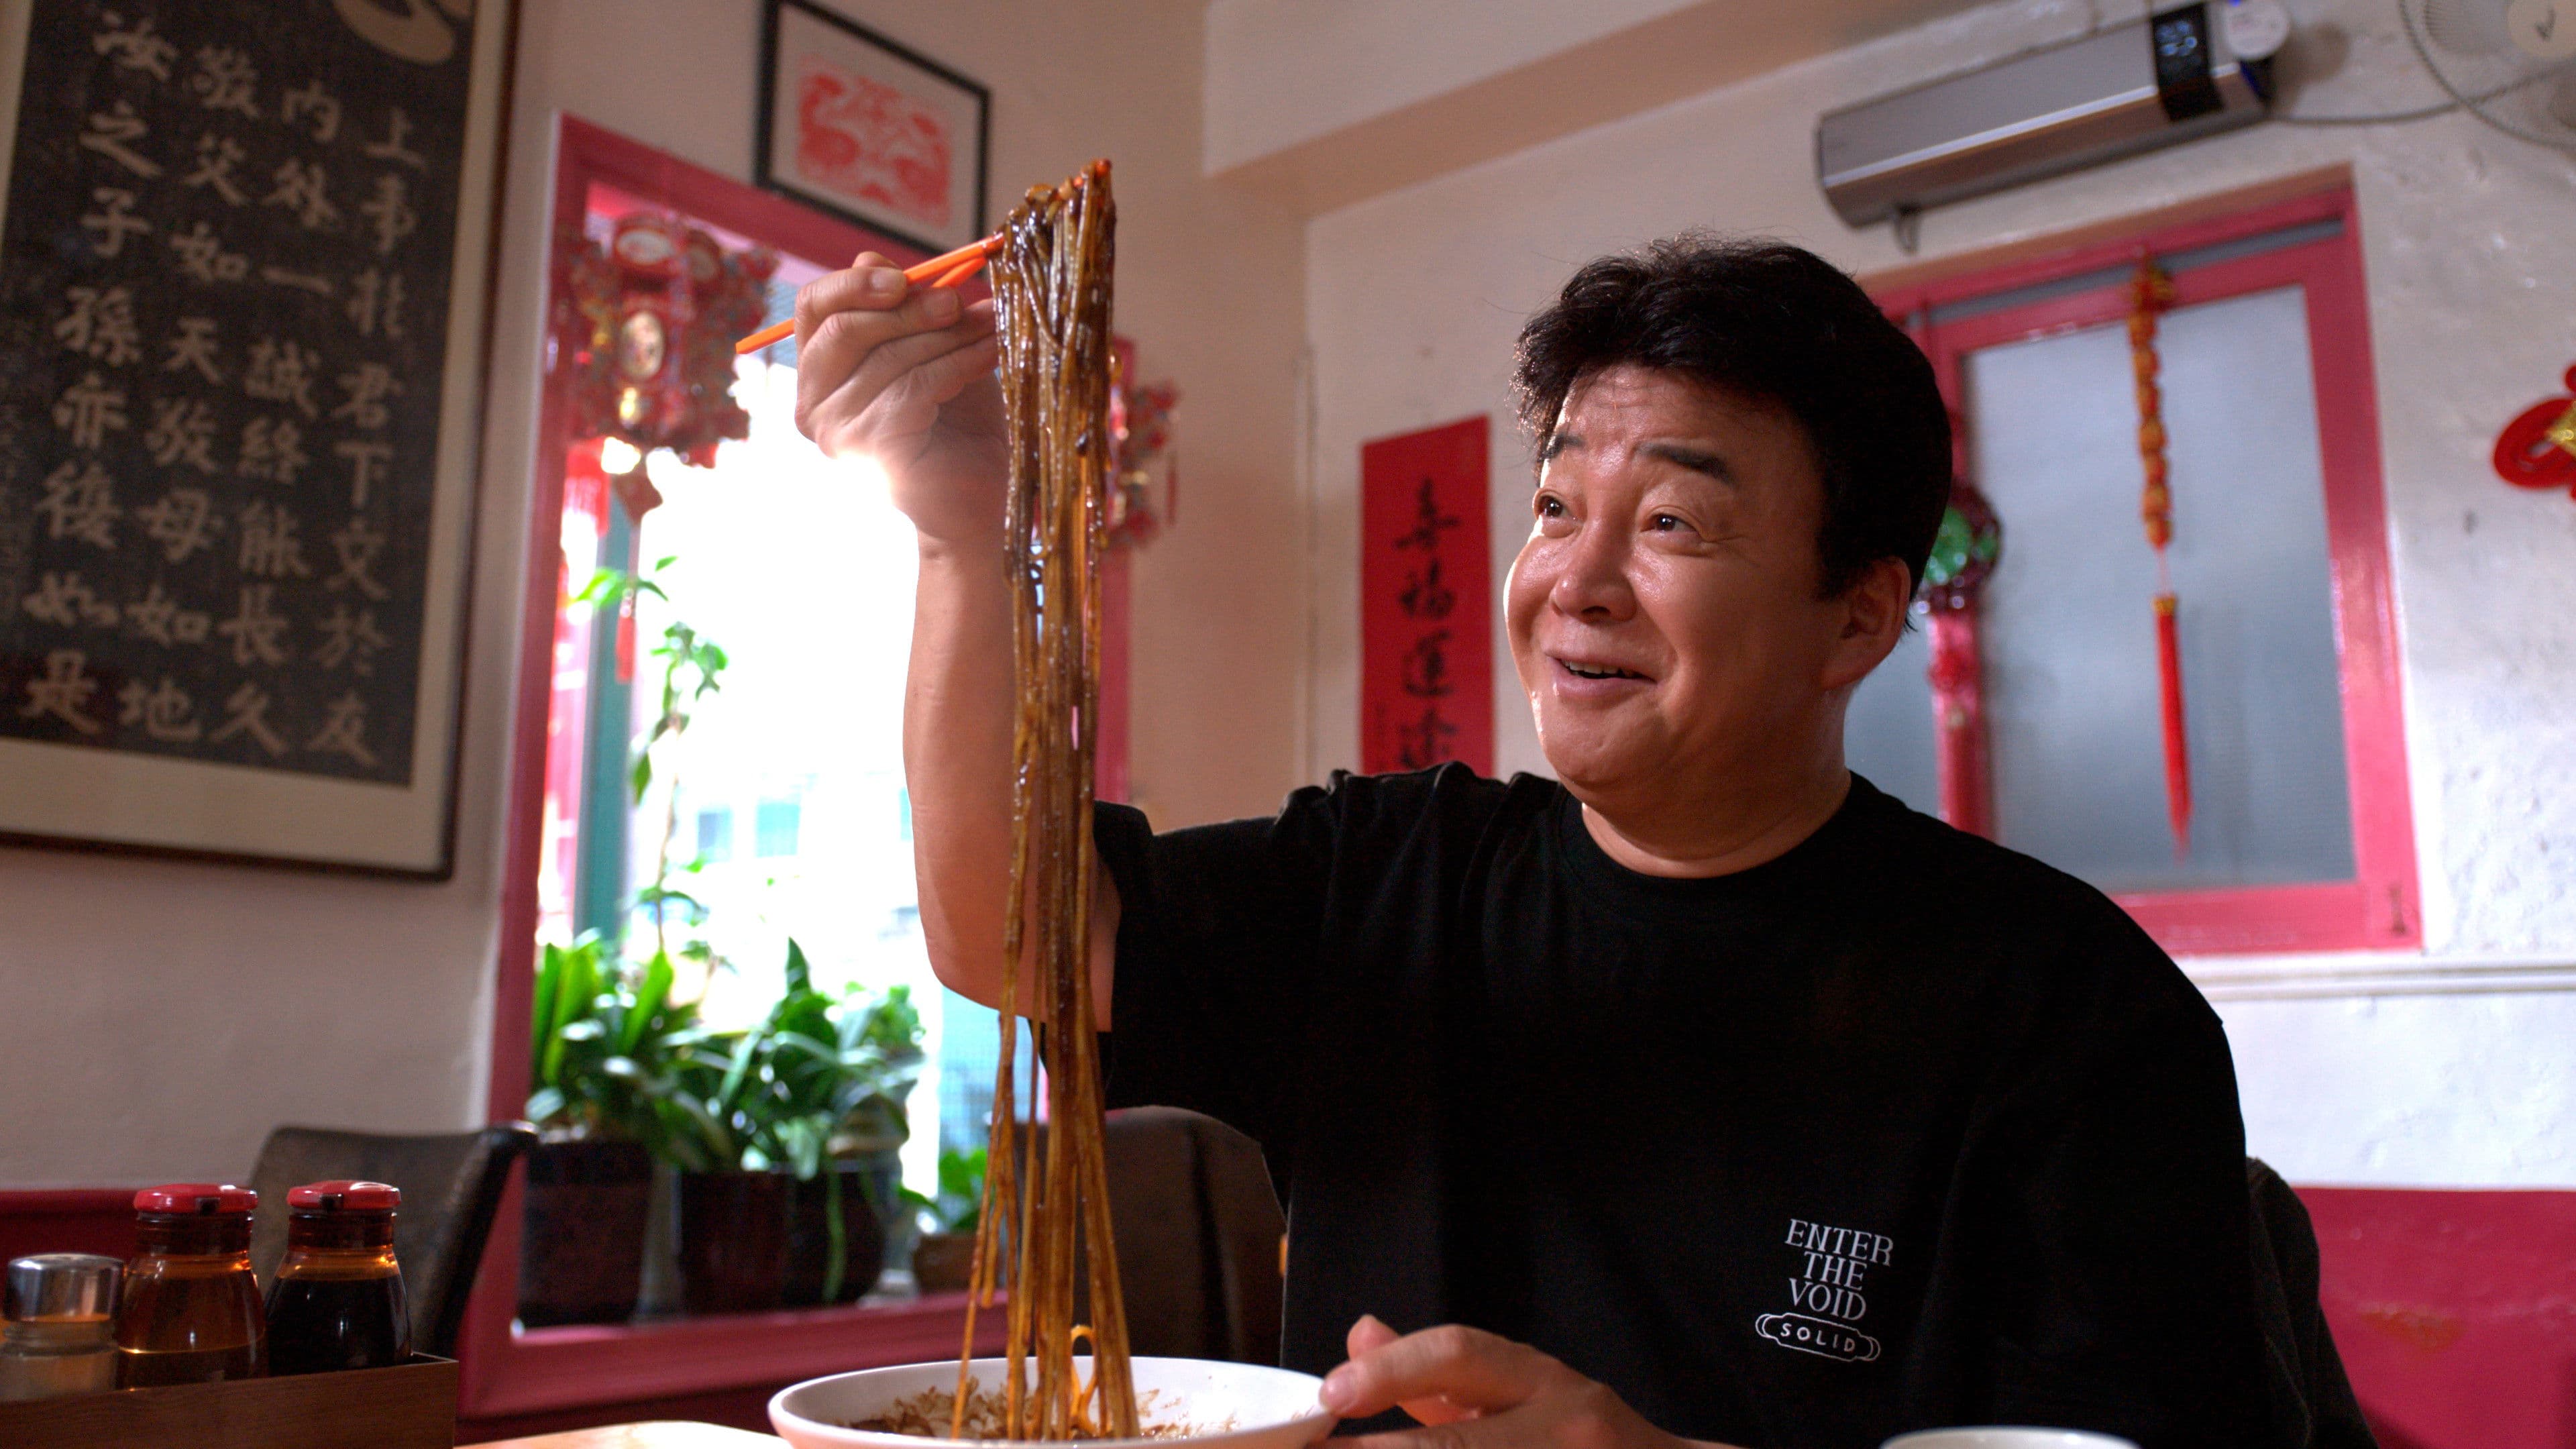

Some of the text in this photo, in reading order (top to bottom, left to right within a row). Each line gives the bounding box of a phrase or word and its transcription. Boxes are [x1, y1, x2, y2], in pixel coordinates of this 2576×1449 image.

[1785, 1219, 1893, 1266] ENTER
[1804, 1251, 1867, 1291] THE
[1789, 1278, 1866, 1320] VOID
[1780, 1323, 1856, 1352] SOLID
